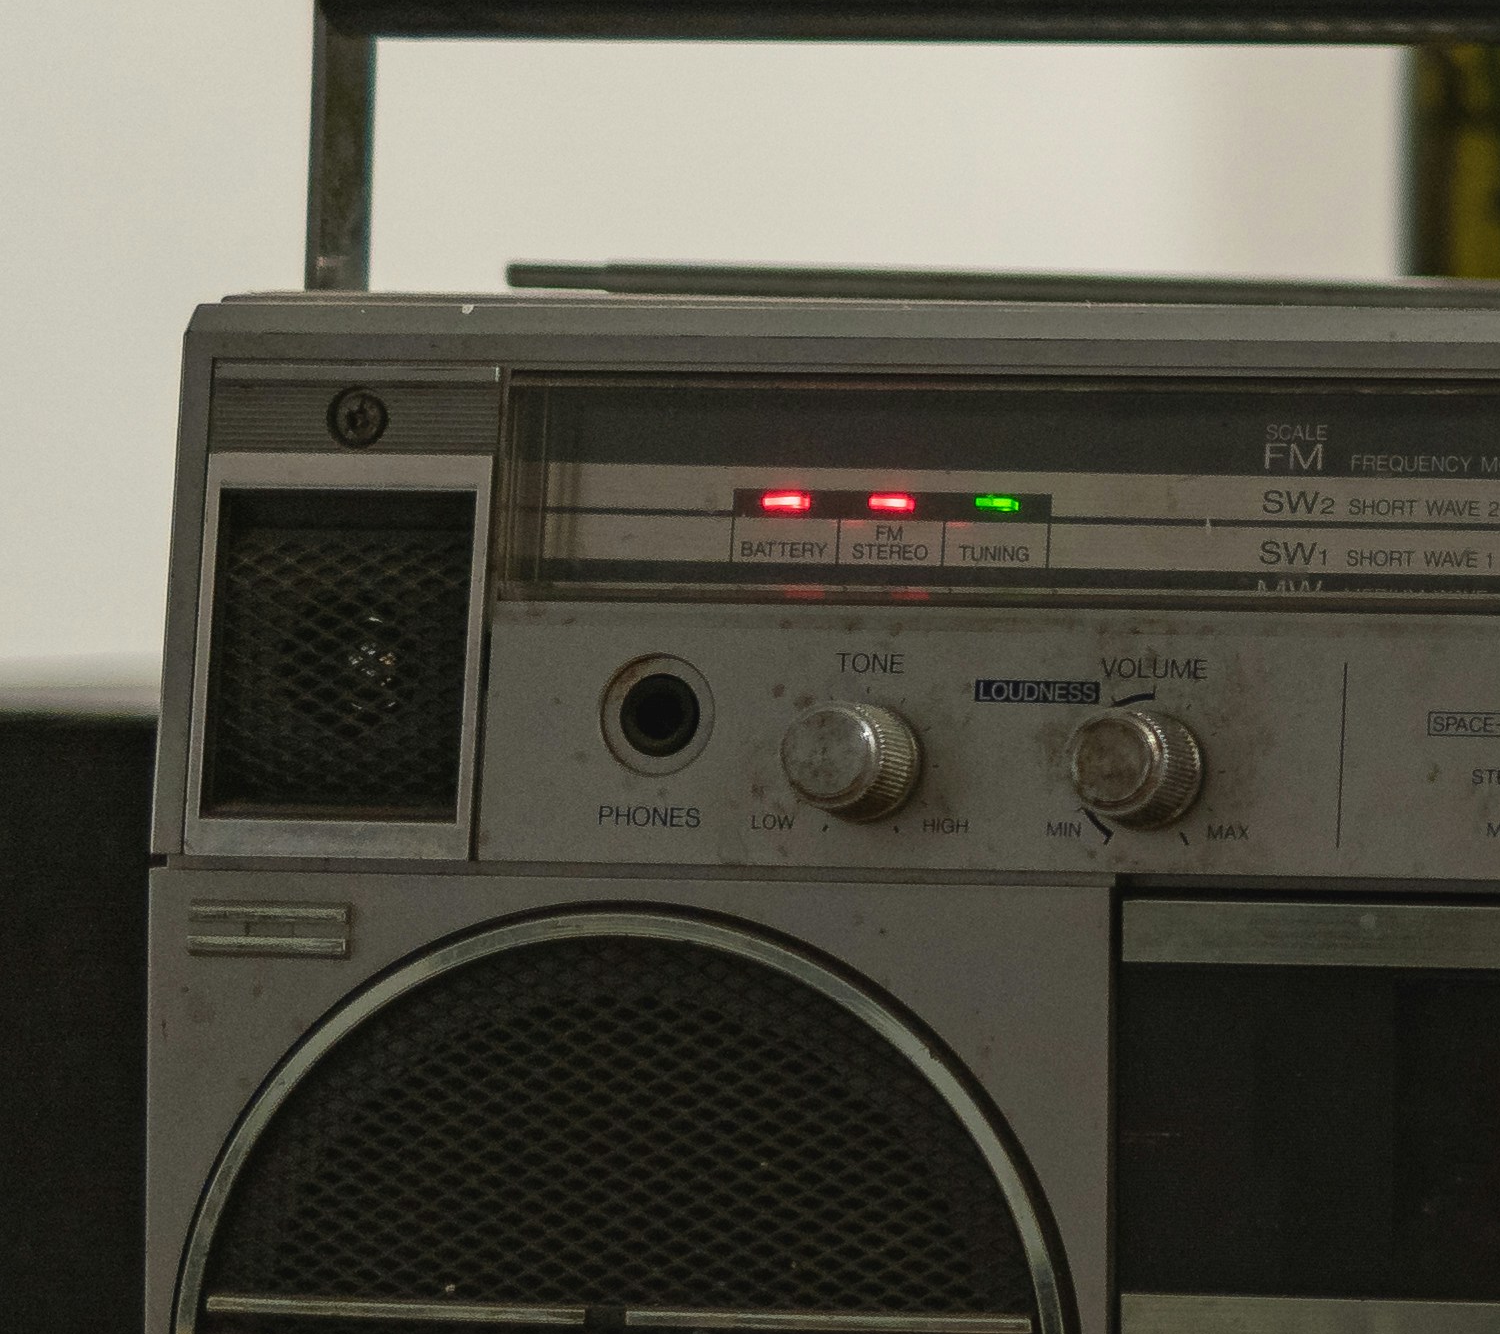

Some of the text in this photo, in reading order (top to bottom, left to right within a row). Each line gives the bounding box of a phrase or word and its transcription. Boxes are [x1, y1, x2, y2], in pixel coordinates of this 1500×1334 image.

[1266, 424, 1328, 441] SCALE
[1263, 443, 1324, 471] FM
[1350, 454, 1472, 474] FREQUENCY
[1262, 489, 1500, 517] SW2 SHORT WAVE 2
[875, 525, 903, 541] FM
[741, 541, 828, 558] BATTERY
[852, 544, 929, 560] STEREO
[959, 545, 1030, 561] TUNING
[1259, 540, 1494, 569] SW1 SHORT WAVE 1
[837, 652, 905, 674] TONE
[1101, 658, 1208, 680] VOLUME
[978, 681, 1097, 702] LOUDNESS
[598, 805, 701, 828] PHONES
[751, 814, 795, 831] LOW
[923, 819, 969, 835] HIGH
[1046, 821, 1082, 837] MIN
[1207, 824, 1249, 840] MAX
